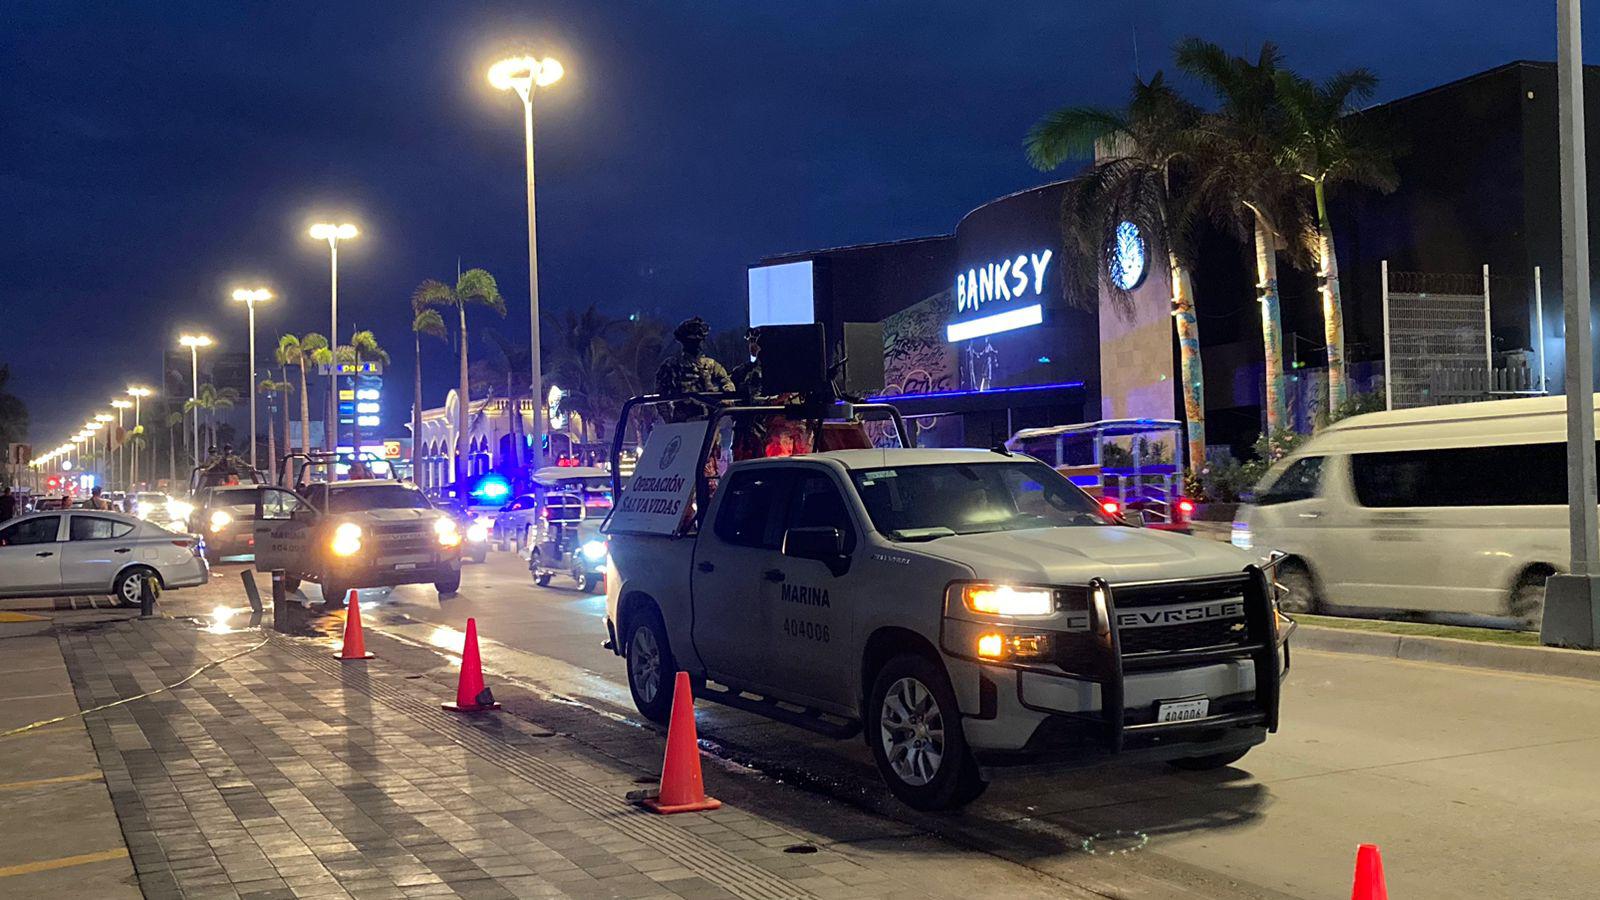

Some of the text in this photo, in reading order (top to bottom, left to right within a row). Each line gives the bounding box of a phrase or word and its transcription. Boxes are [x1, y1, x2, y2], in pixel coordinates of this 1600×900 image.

[957, 249, 1052, 312] BANKSY
[633, 474, 685, 493] OPERACIÓN
[620, 497, 680, 515] SALVAVIDAS
[781, 583, 831, 609] MARINA
[1067, 602, 1244, 629] CEVROLE
[783, 617, 830, 644] 404006
